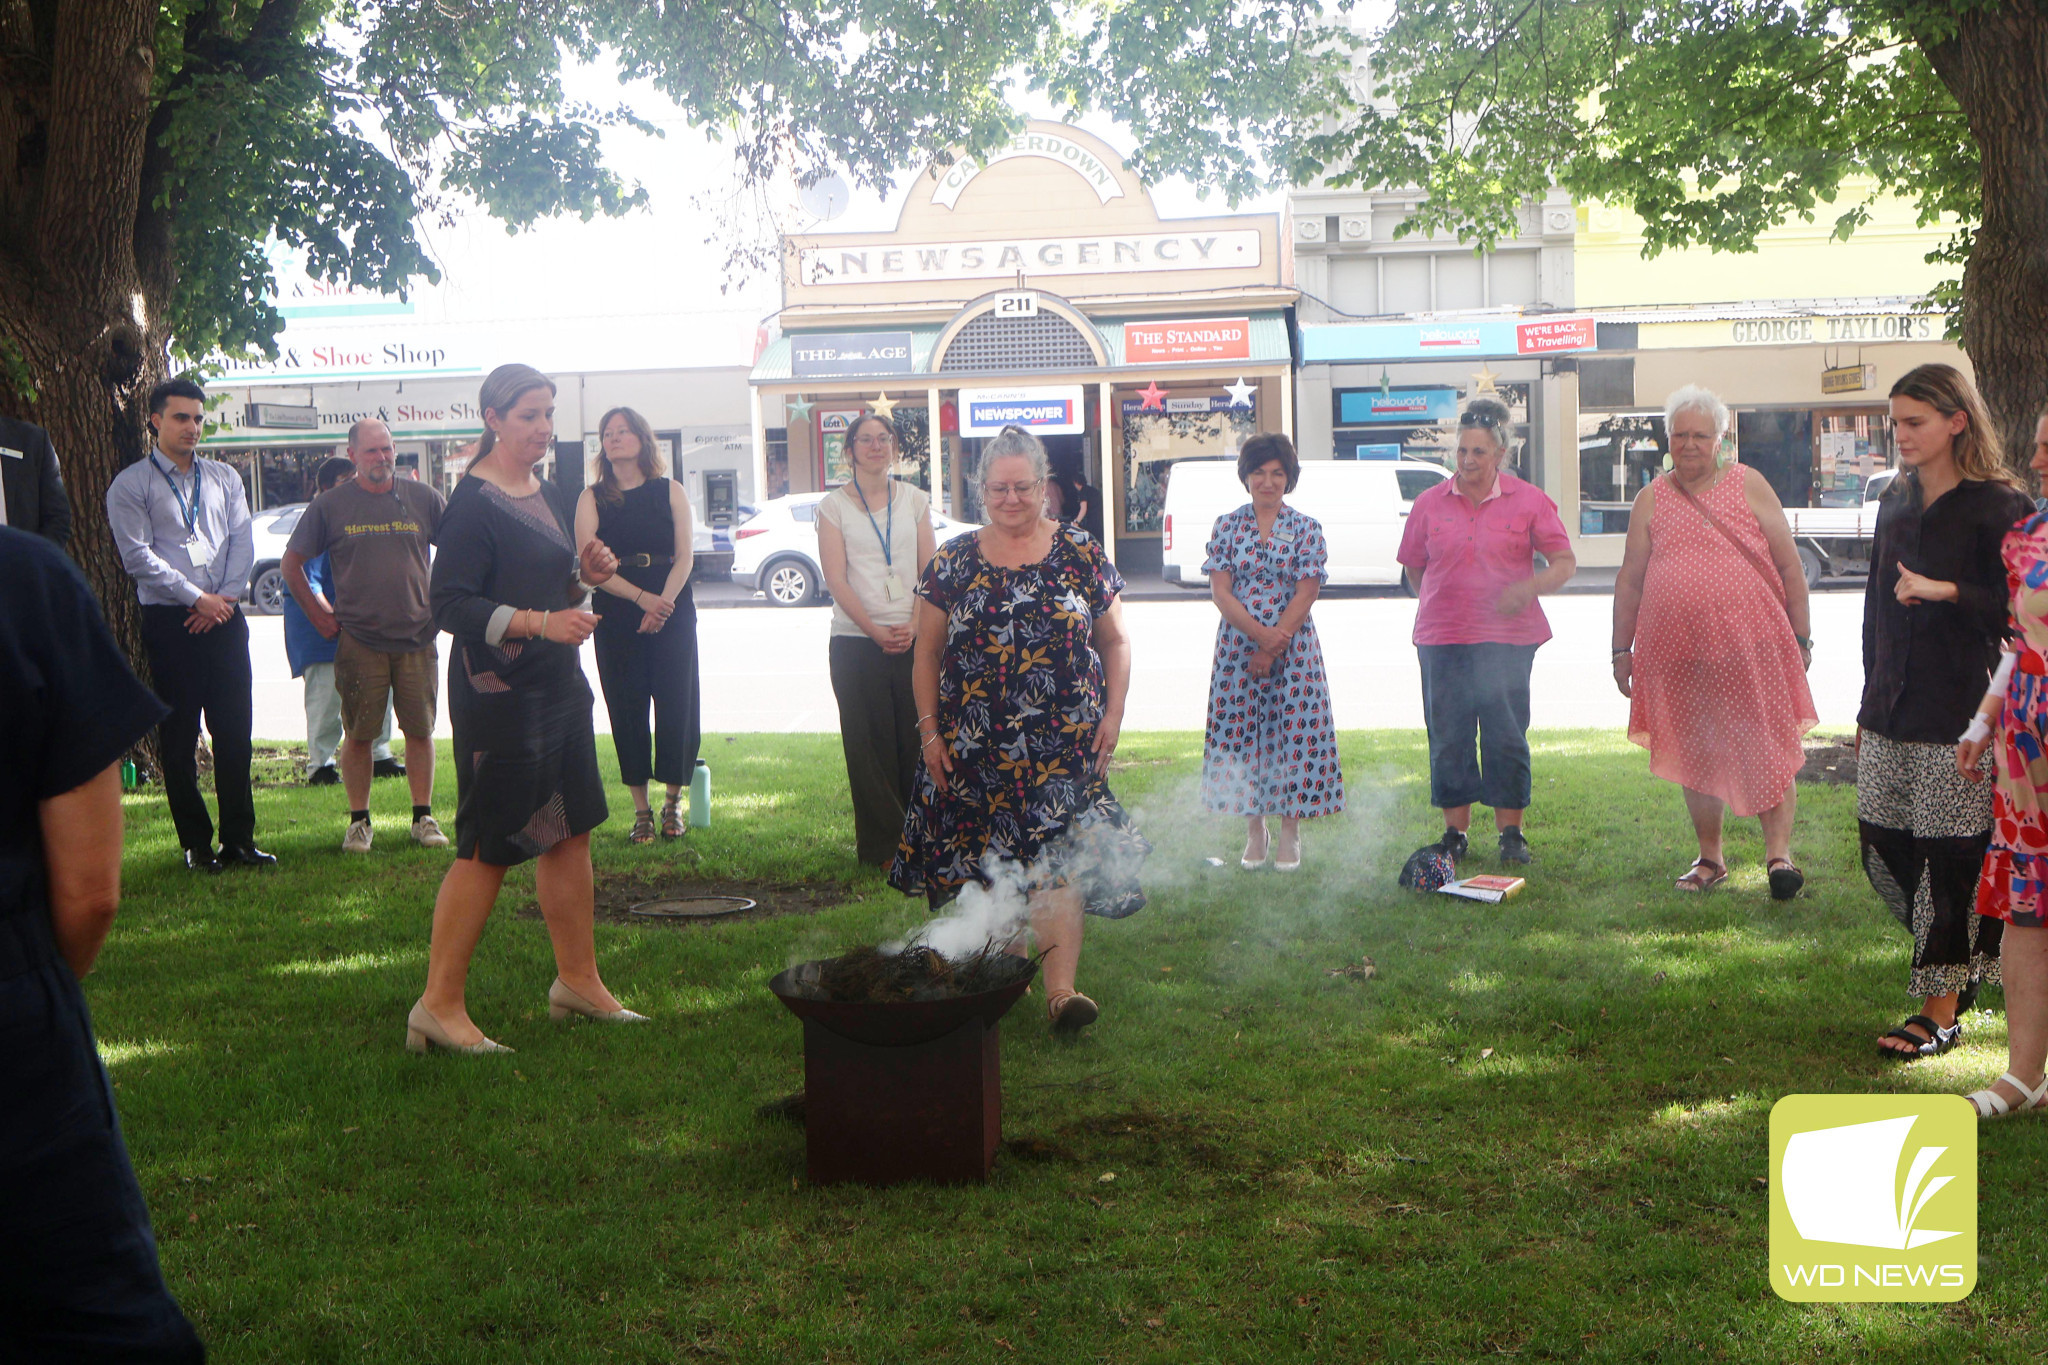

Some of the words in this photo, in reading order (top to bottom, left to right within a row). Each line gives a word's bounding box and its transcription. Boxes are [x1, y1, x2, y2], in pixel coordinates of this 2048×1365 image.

[840, 236, 1218, 275] NEWSAGENCY
[1002, 298, 1031, 312] 211
[1132, 331, 1164, 346] THE
[1166, 328, 1243, 345] STANDARD
[1525, 324, 1552, 337] WE'RE
[1554, 323, 1577, 334] BACK
[1732, 318, 1813, 343] GEORGE
[1826, 316, 1930, 340] TAYLOR'S
[1526, 338, 1535, 349] &
[1536, 333, 1587, 348] Travelling!
[285, 347, 301, 368] &
[313, 346, 373, 368] Shoe
[383, 343, 446, 367] Shop
[795, 348, 837, 362] THE
[868, 347, 907, 360] AGE
[1171, 400, 1205, 410] Sunday
[1371, 395, 1427, 407] helloworld
[377, 405, 390, 422] &
[397, 404, 444, 422] Shoe
[974, 406, 1063, 421] NEWSPOWER
[724, 443, 742, 451] ATM
[344, 523, 391, 534] Harvest
[391, 521, 420, 532] Rock
